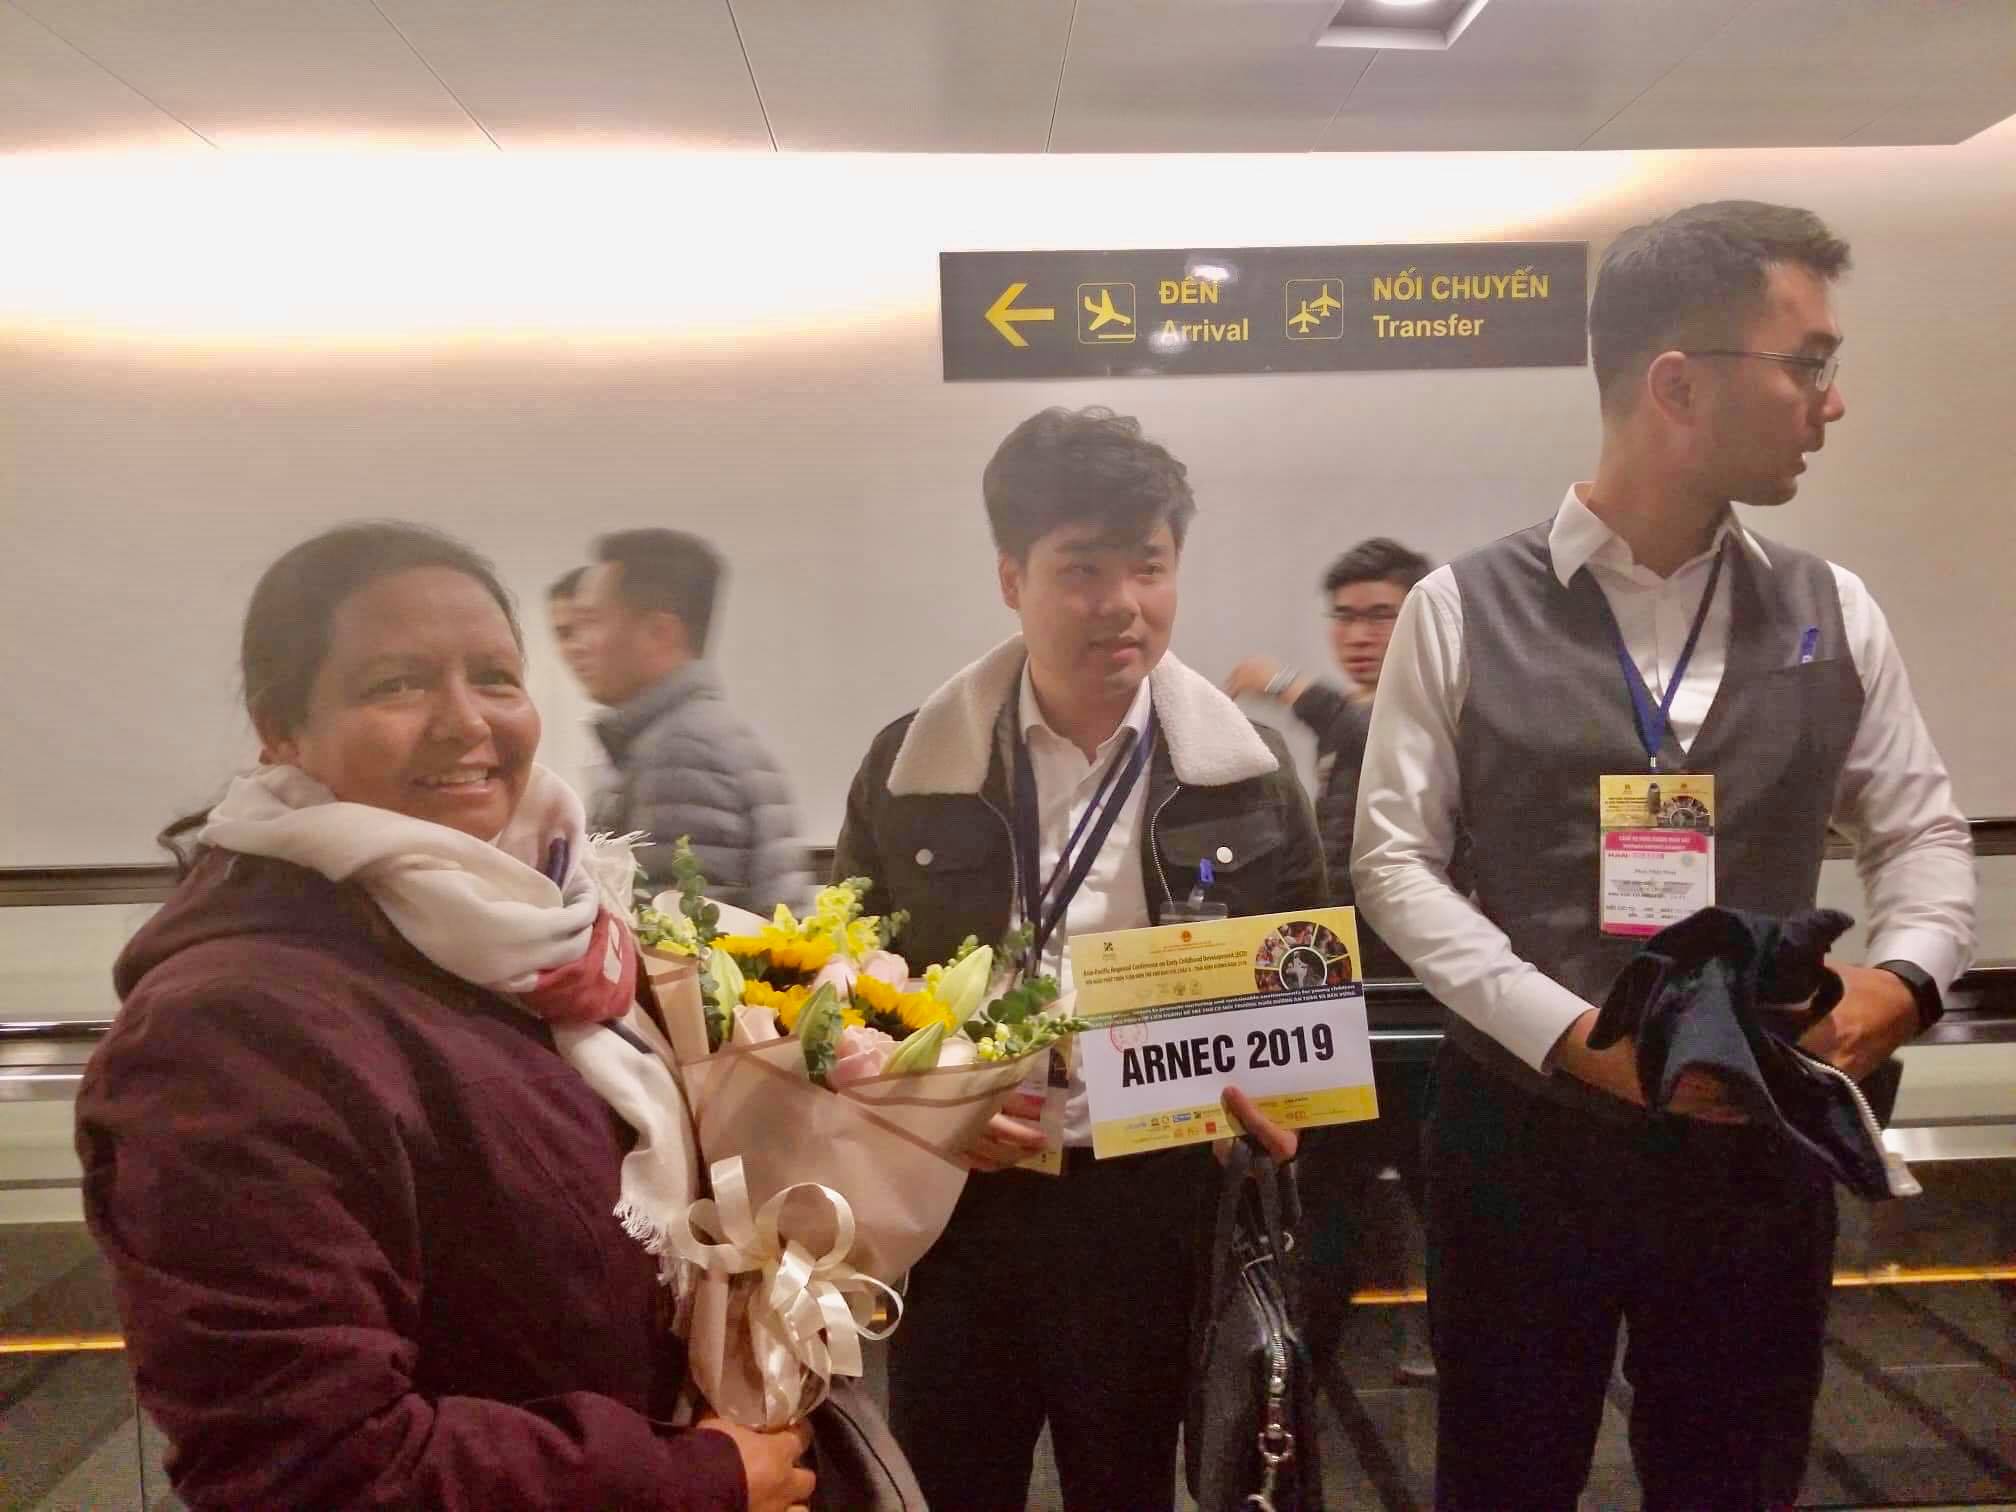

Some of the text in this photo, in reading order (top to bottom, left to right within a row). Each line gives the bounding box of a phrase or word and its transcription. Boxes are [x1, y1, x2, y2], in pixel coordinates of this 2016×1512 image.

[1373, 265, 1549, 301] NỐI CHUYẾN
[1160, 318, 1249, 342] Arrival
[1373, 315, 1484, 338] Transfer
[1121, 1023, 1335, 1088] ARNEC 2019
